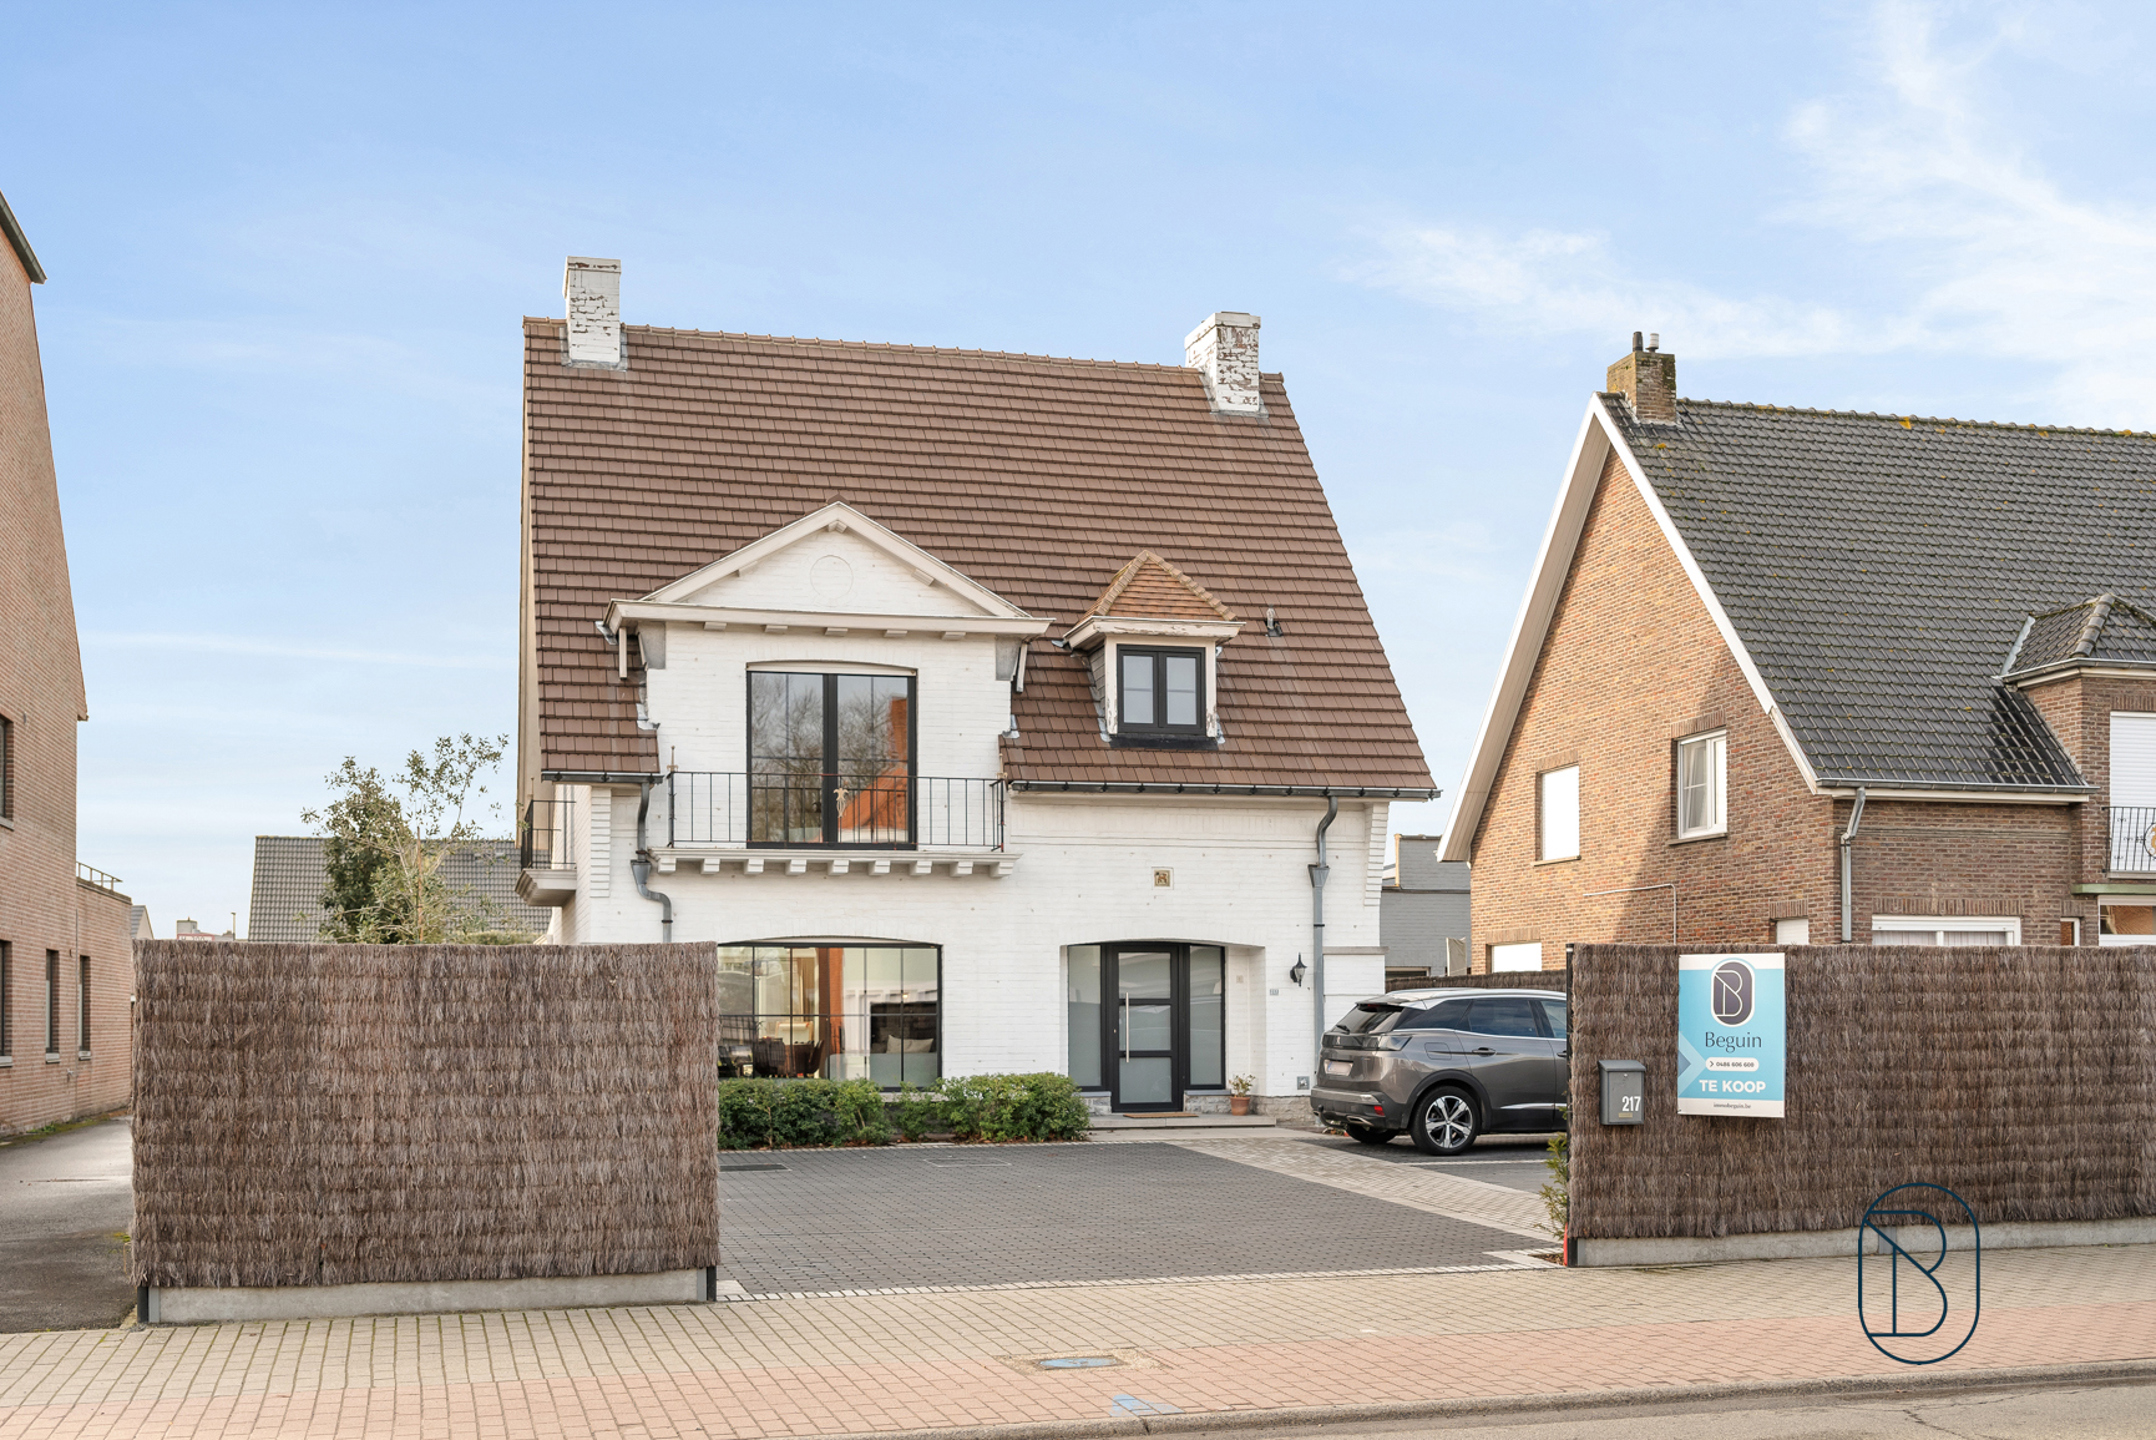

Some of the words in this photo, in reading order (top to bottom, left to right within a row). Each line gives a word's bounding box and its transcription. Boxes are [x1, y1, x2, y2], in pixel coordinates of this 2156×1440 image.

[1705, 1031, 1762, 1053] Beguin
[1699, 1080, 1718, 1092] TE
[1722, 1080, 1766, 1093] KOOP
[1622, 1095, 1641, 1112] 217
